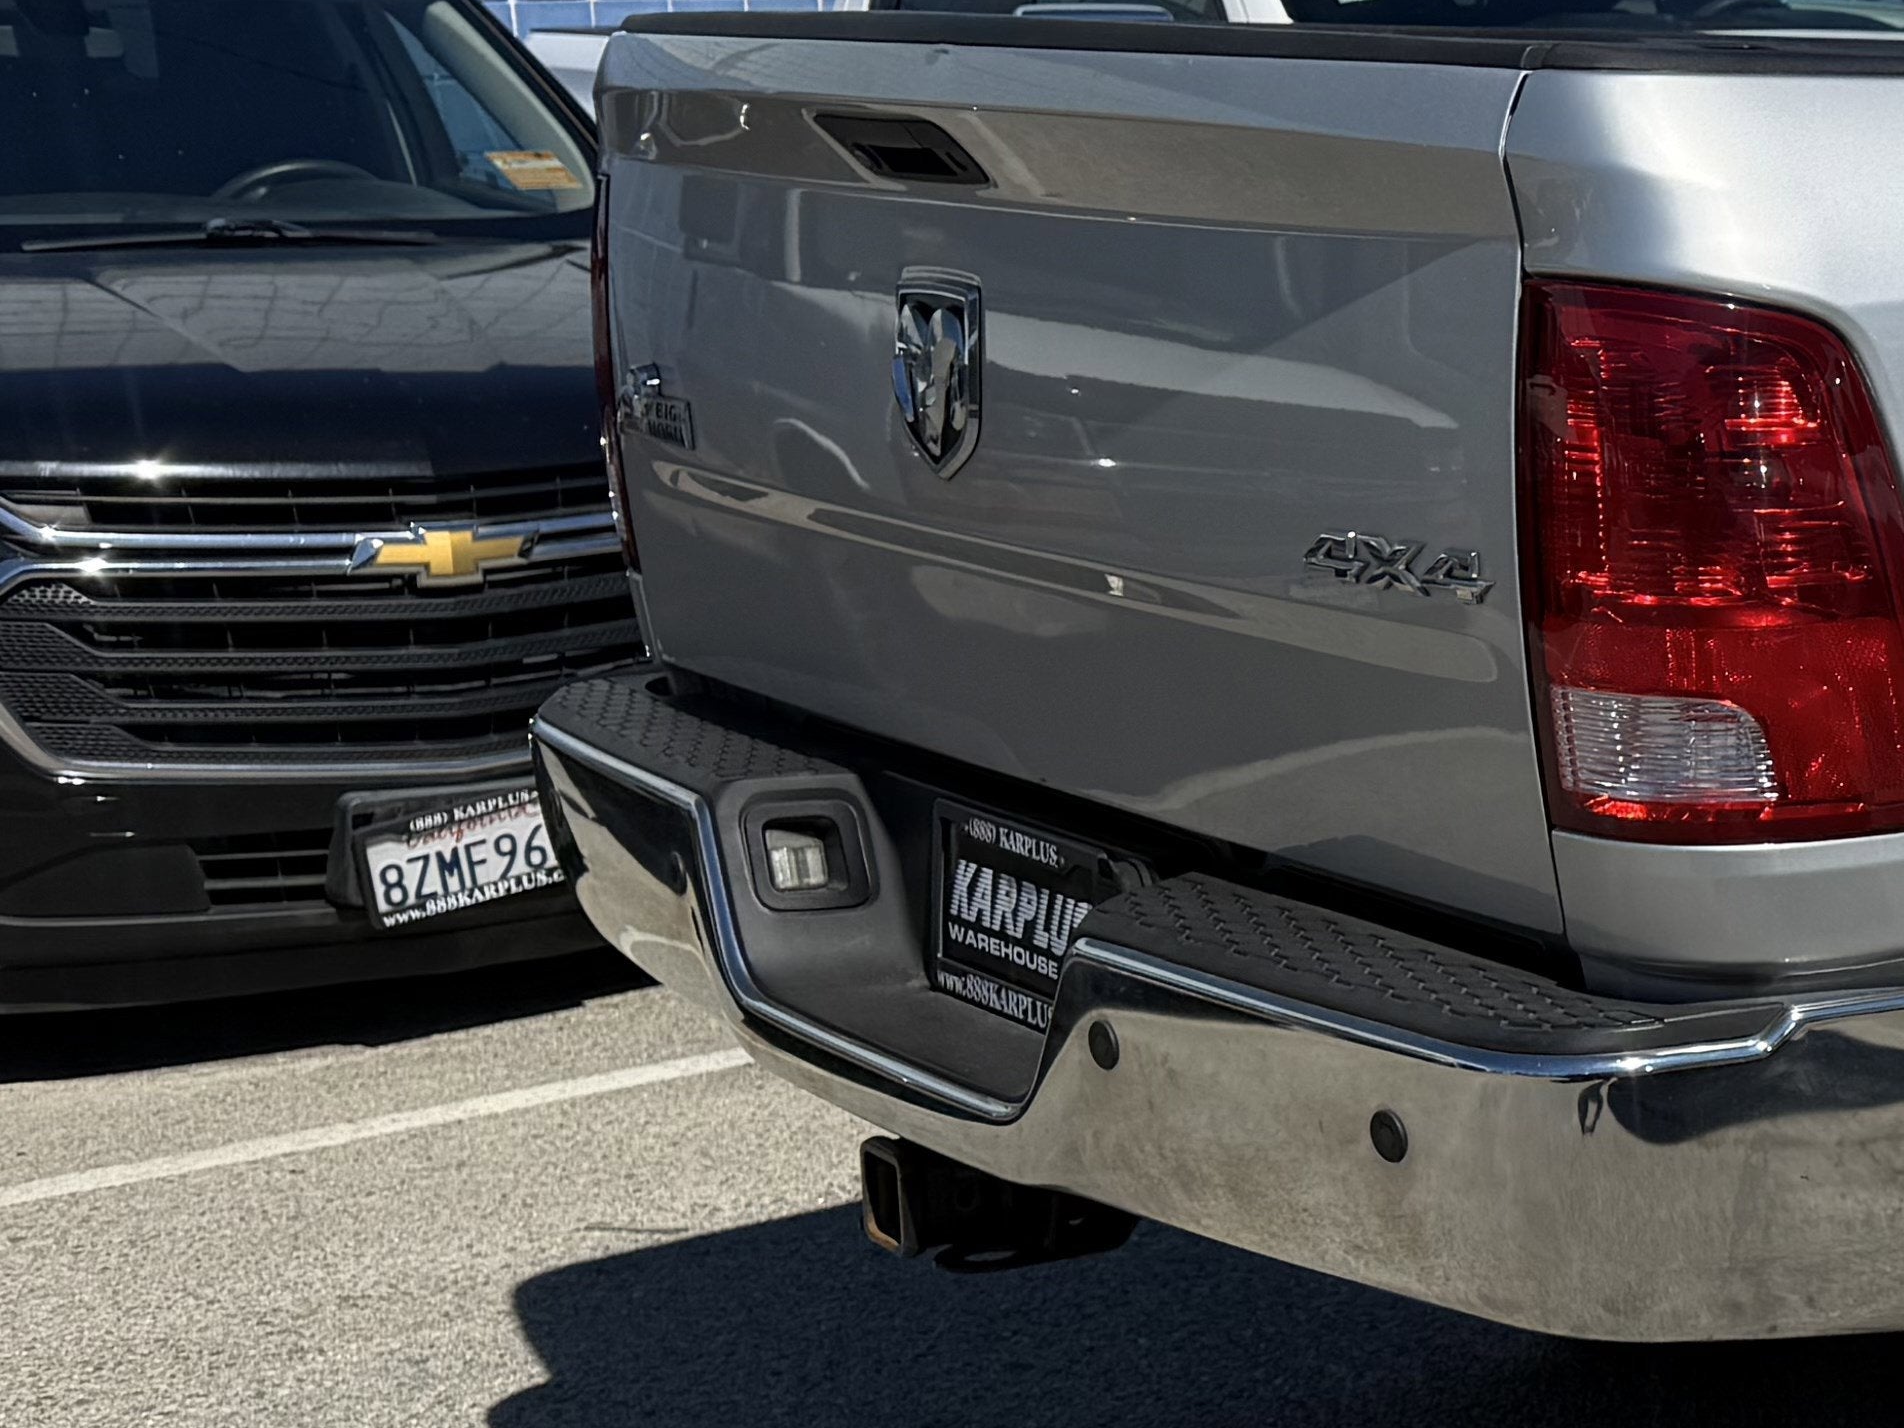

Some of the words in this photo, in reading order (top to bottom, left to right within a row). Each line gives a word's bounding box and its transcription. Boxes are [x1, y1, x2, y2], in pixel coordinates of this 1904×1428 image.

[655, 401, 677, 422] BIG
[406, 805, 542, 850] California
[409, 810, 449, 833] (888)
[379, 824, 548, 908] 8ZMF96
[948, 922, 1059, 981] WAREHOUSE
[937, 969, 1053, 1029] www.888KARPLU
